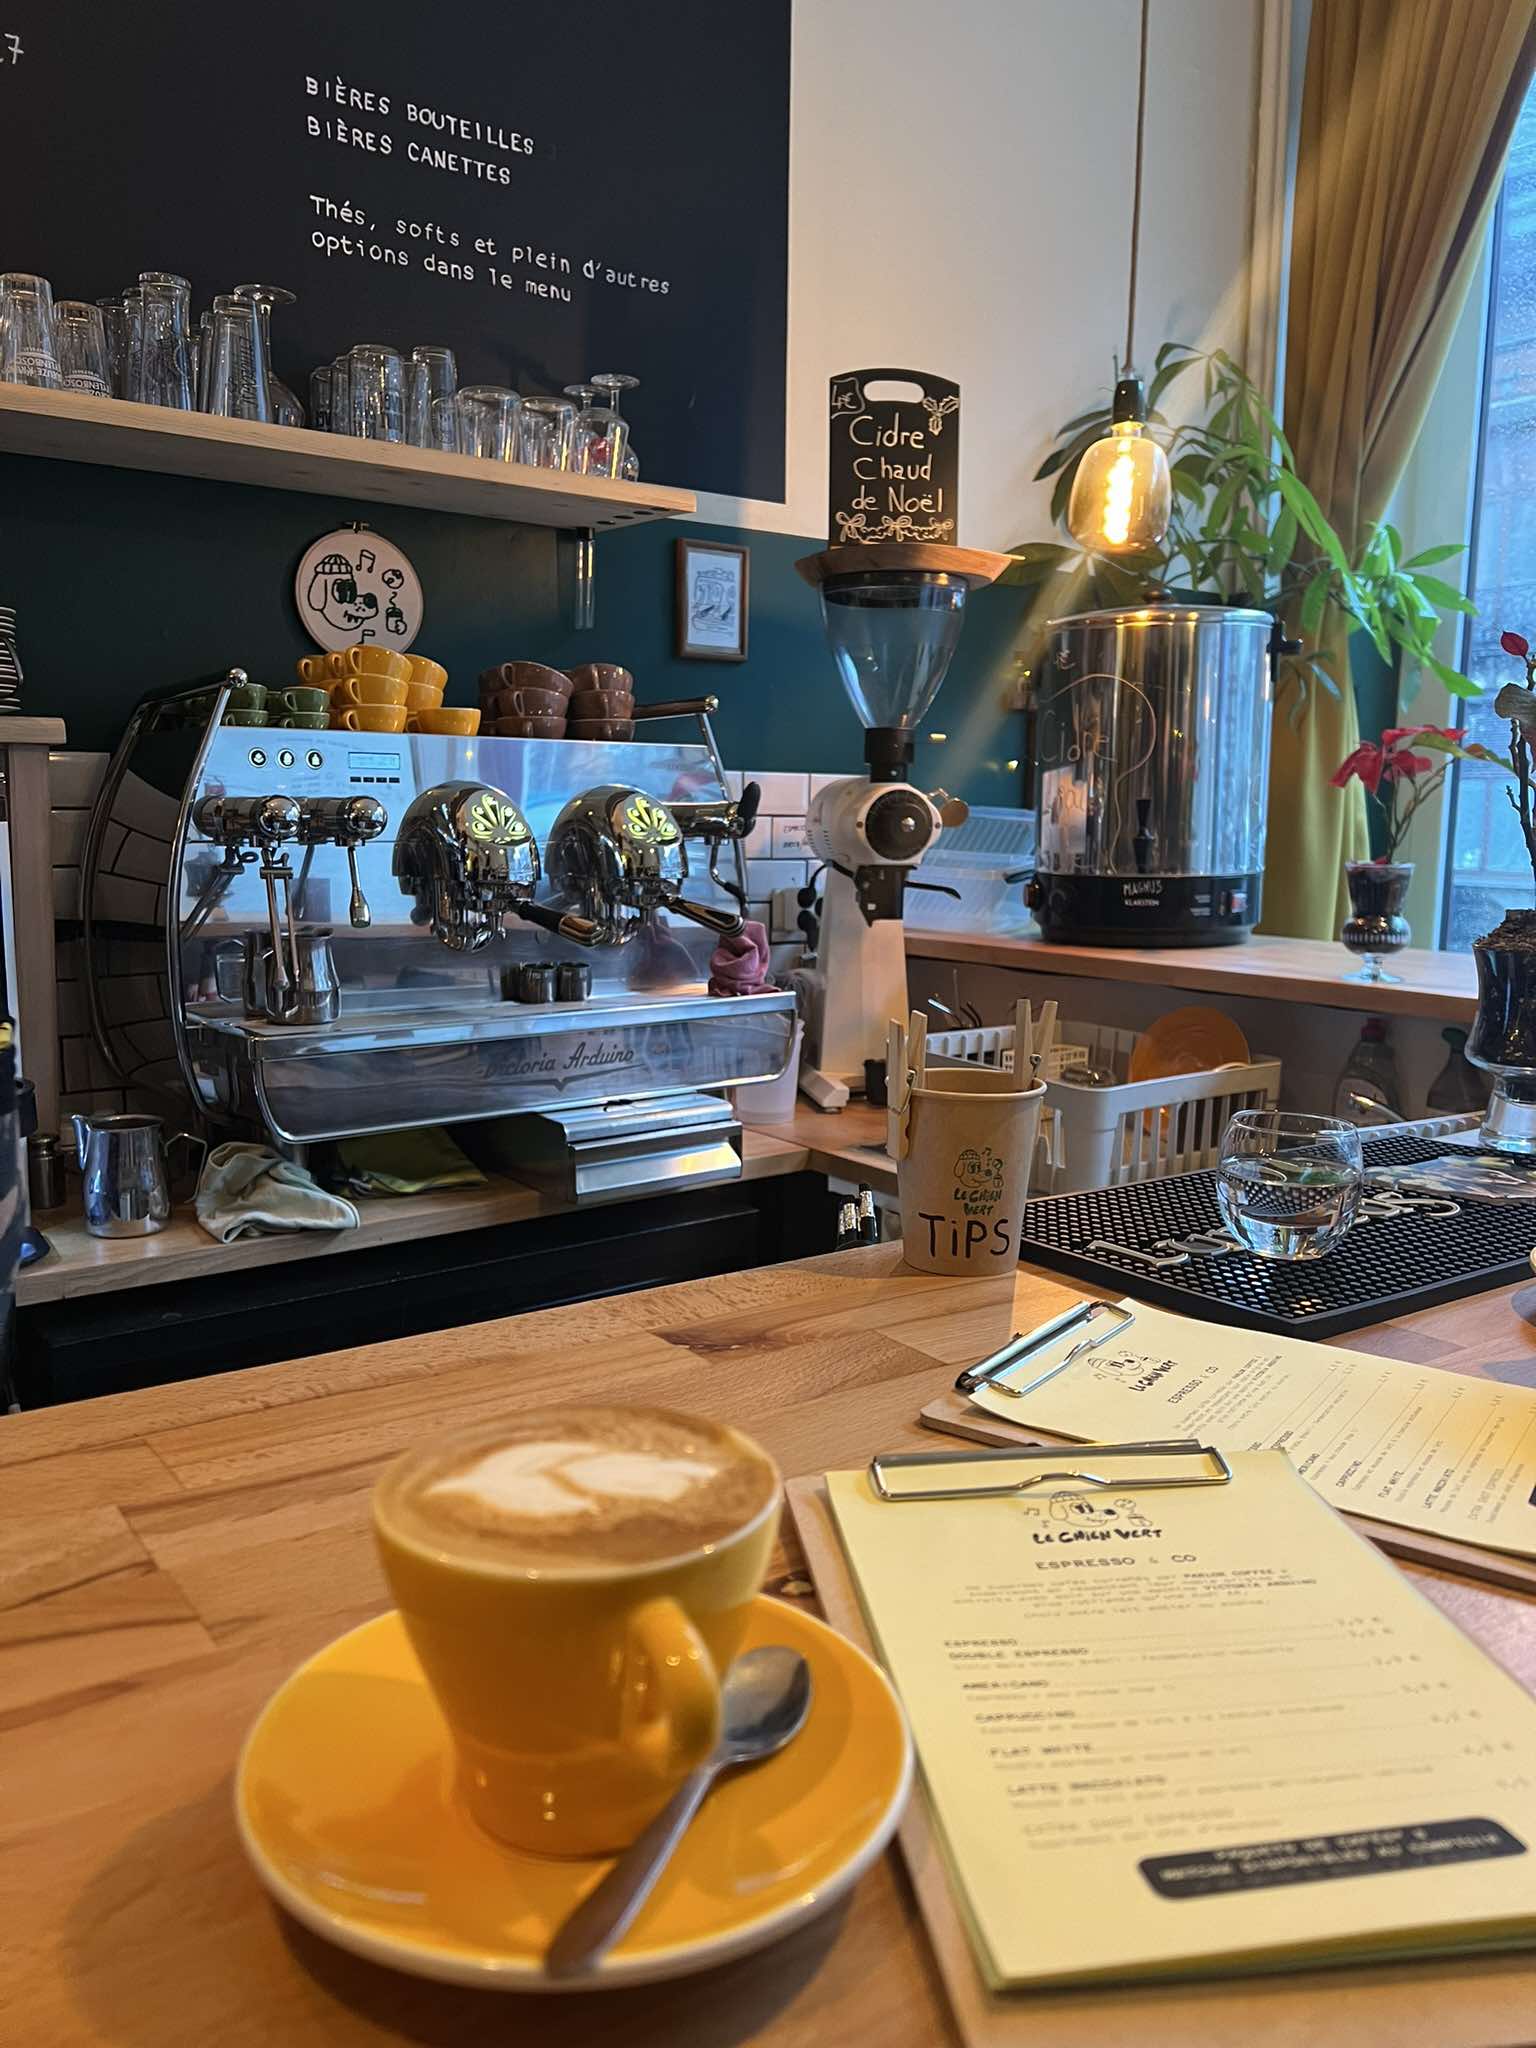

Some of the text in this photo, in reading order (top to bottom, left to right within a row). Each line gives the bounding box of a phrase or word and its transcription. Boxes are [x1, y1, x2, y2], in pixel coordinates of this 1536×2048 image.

[305, 75, 535, 155] BIÈRES BOUTEILLES
[306, 114, 511, 185] BIÈRES CANETTES
[310, 195, 670, 295] Thés, softs et plein d'autres
[424, 253, 474, 281] dans
[489, 268, 513, 289] le
[526, 279, 572, 302] menu
[849, 412, 925, 449] Cidre
[853, 453, 932, 481] Chaud
[851, 484, 943, 513] de Noël
[562, 1041, 635, 1070] Arduino
[1035, 1557, 1136, 1571] ESPRESSO
[1171, 1553, 1197, 1563] CO
